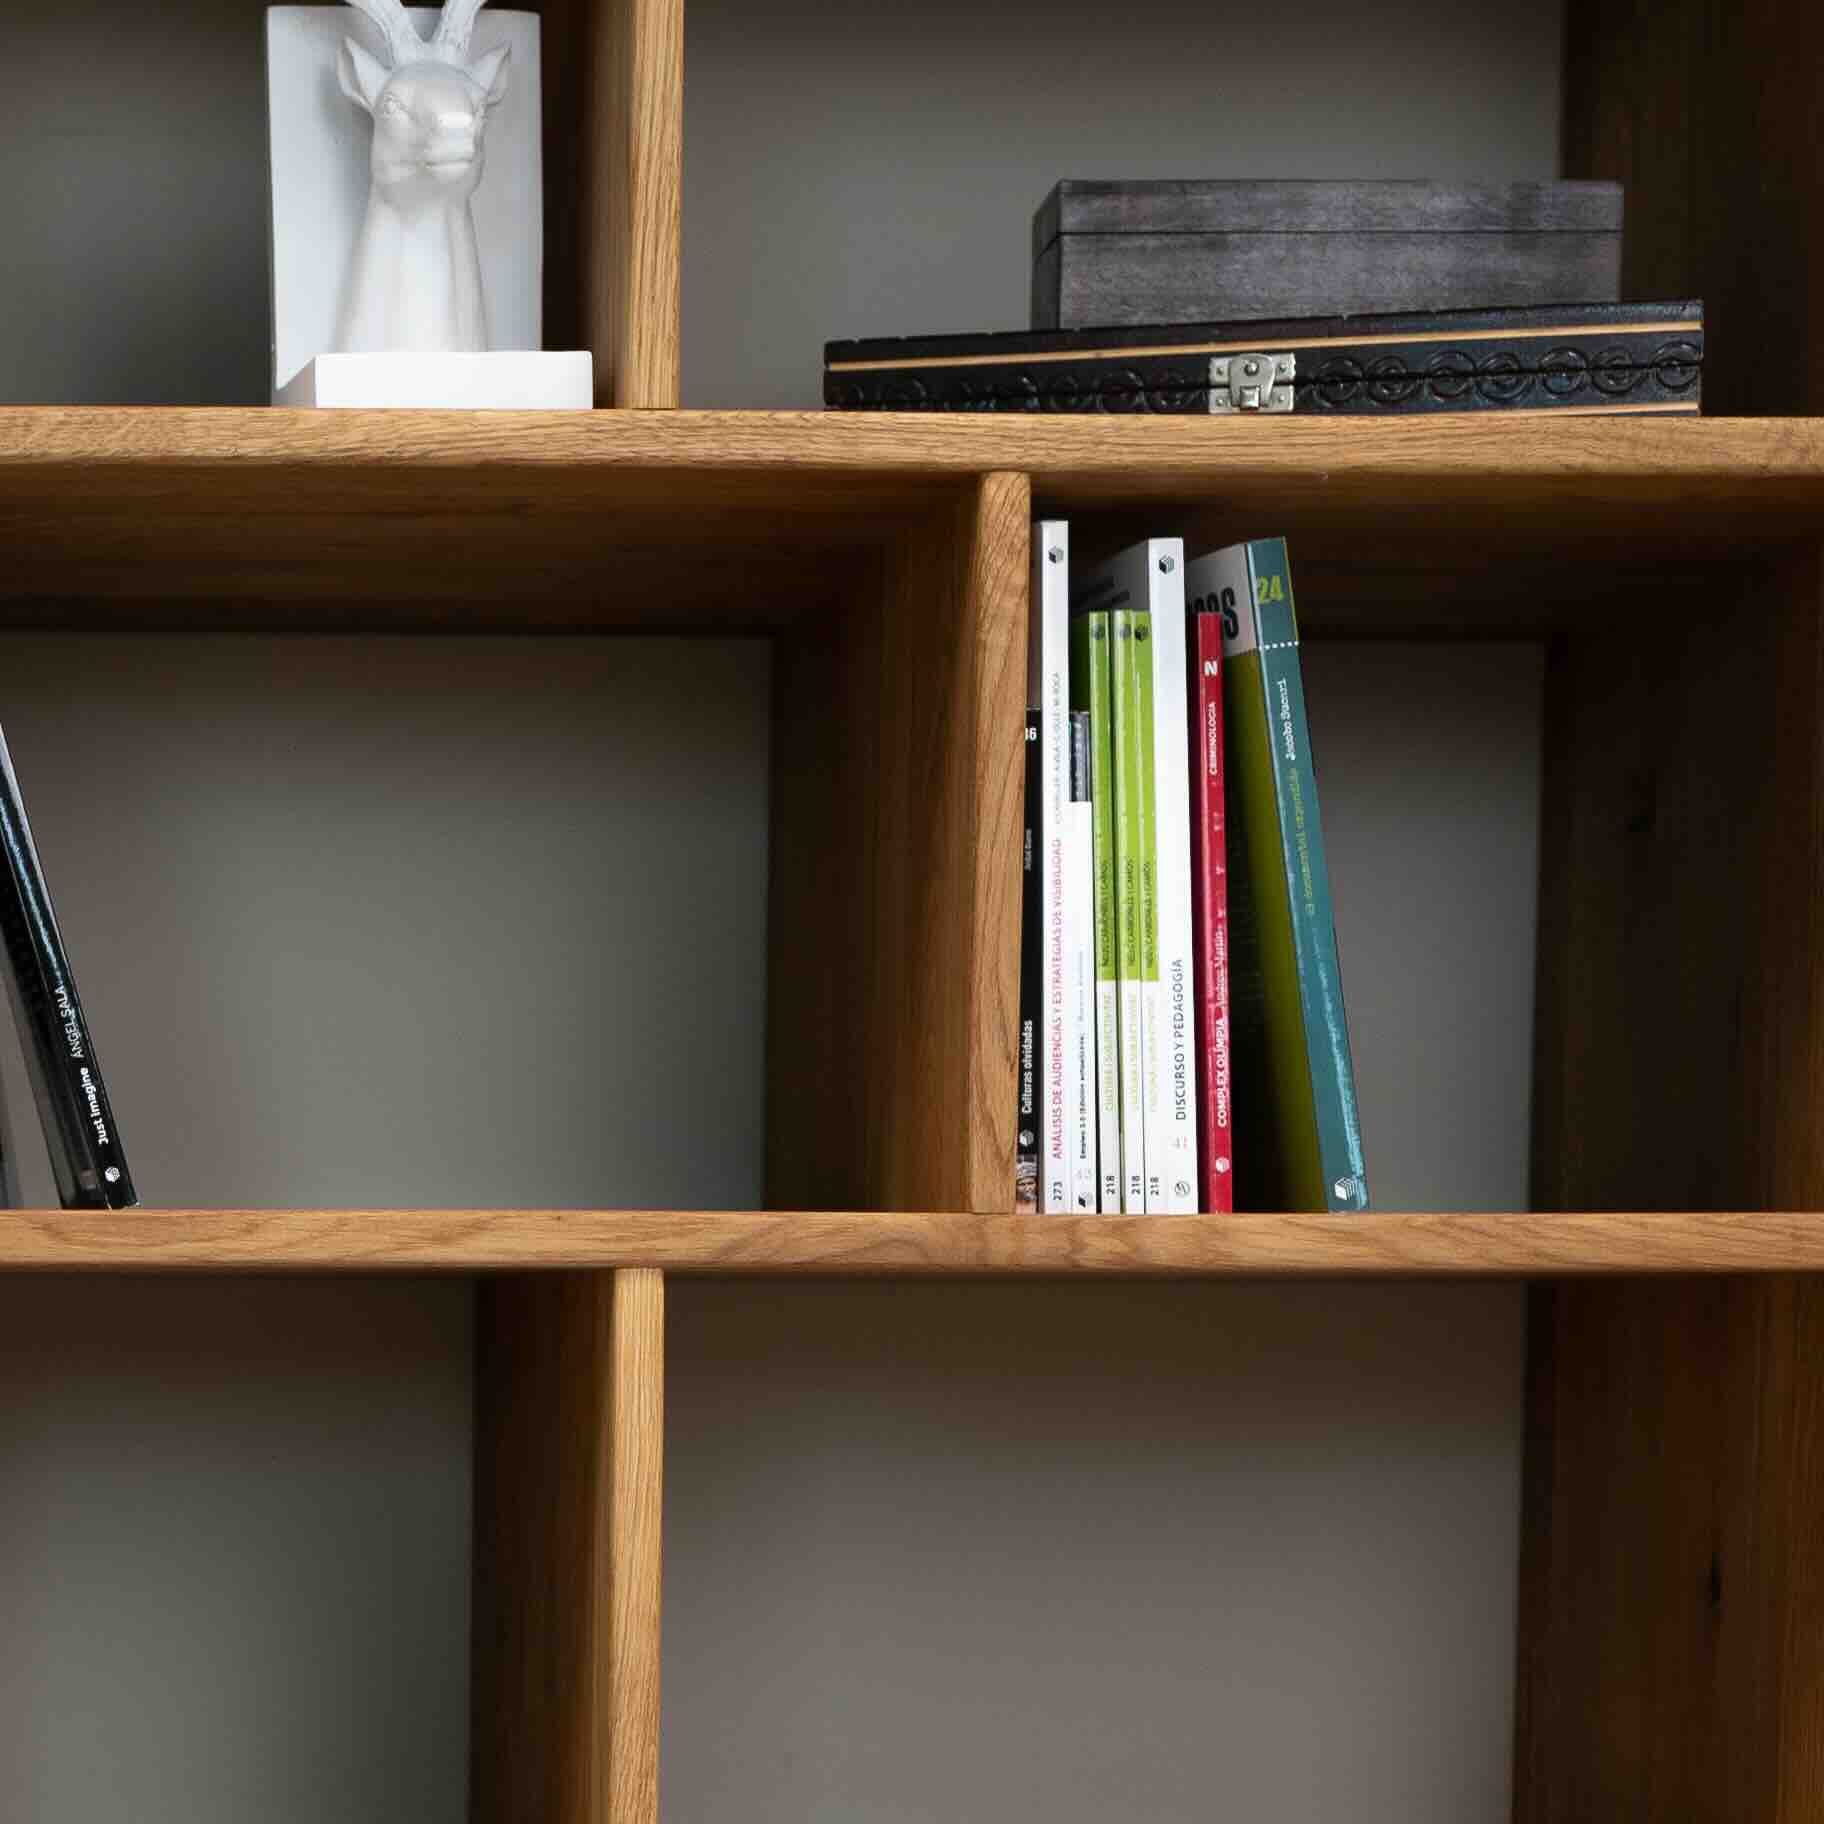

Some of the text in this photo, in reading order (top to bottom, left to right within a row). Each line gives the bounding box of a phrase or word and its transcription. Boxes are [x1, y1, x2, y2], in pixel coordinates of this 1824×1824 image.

[1257, 574, 1284, 605] 24
[1052, 927, 1062, 1004] ESTRATEGIAS
[53, 984, 73, 1017] SALA
[1170, 958, 1184, 1038] PEDAGOGÍA
[1052, 1017, 1062, 1086] AUDIENCIAS
[1053, 1088, 1062, 1104] DE
[1174, 1052, 1186, 1120] DISCURSO
[1216, 1070, 1227, 1127] COMPLEX
[92, 1117, 110, 1145] Just
[1051, 1107, 1062, 1159] ANÁLISIS
[1053, 1180, 1063, 1201] 273
[1106, 1175, 1115, 1194] 218
[1132, 1175, 1140, 1195] 218
[1150, 1176, 1159, 1196] 218
